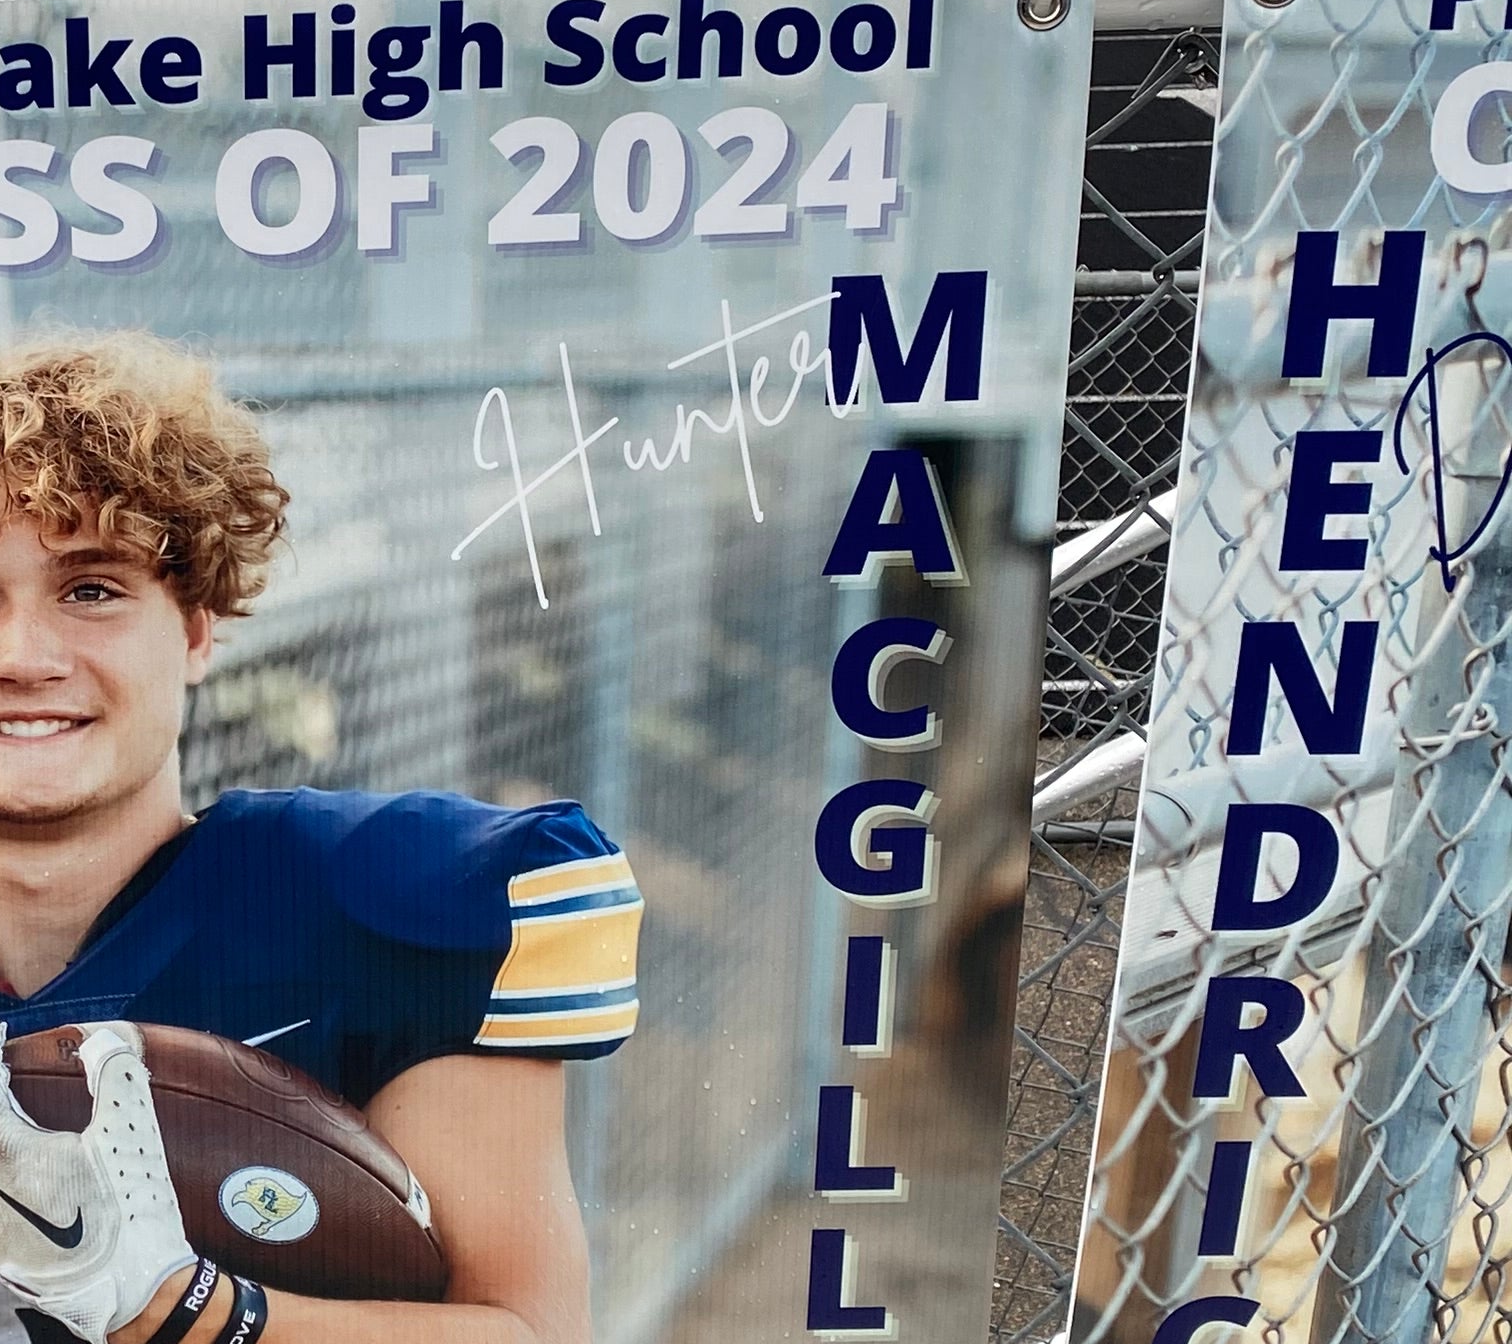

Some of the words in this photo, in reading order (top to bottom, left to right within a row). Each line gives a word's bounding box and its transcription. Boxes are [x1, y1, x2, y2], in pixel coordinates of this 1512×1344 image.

[243, 0, 504, 121] High
[215, 123, 434, 256] OF
[487, 102, 899, 246] 2024
[451, 290, 868, 610] Hunter
